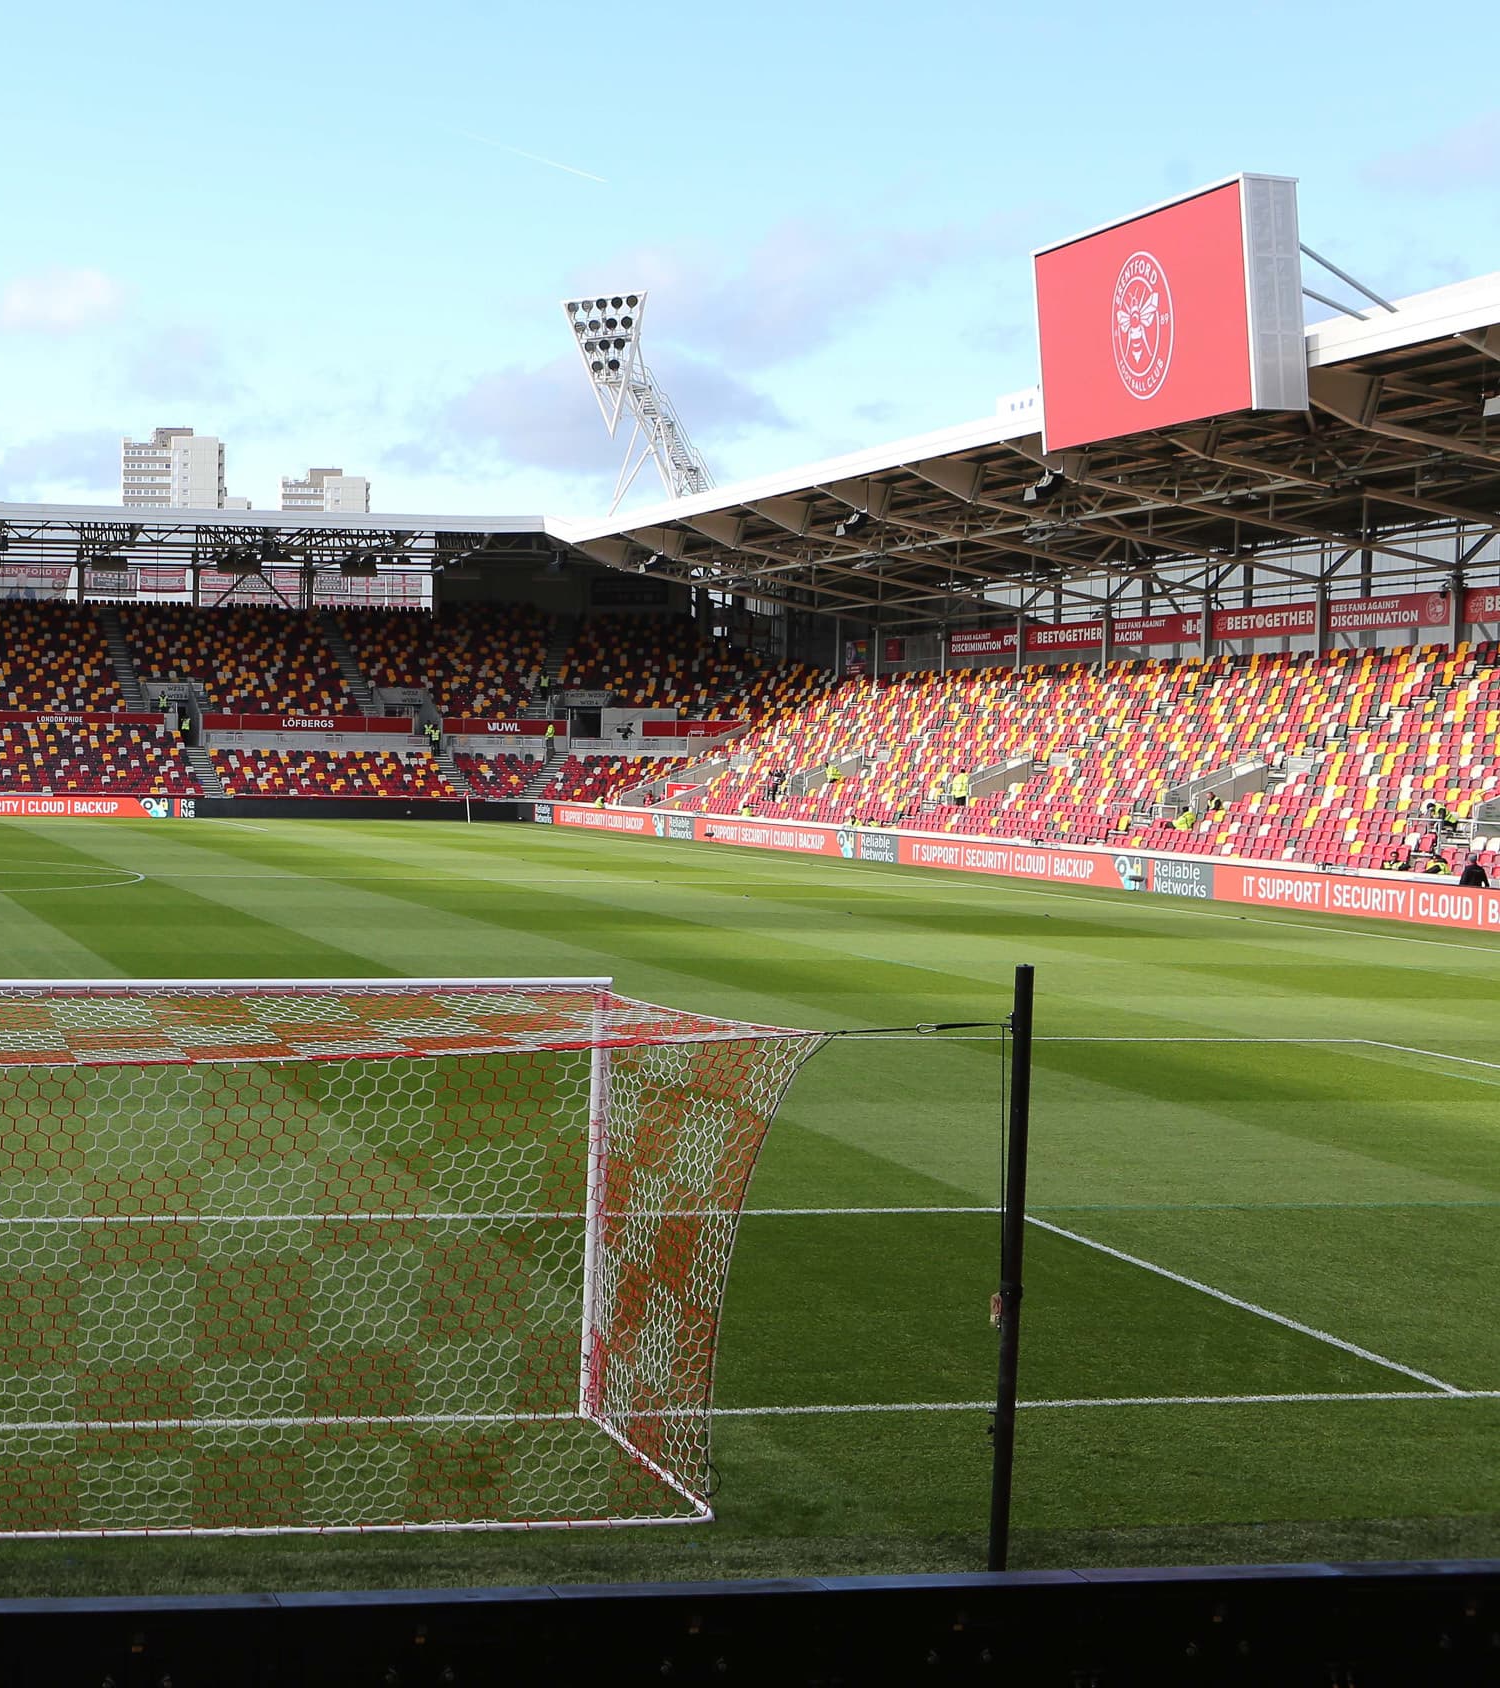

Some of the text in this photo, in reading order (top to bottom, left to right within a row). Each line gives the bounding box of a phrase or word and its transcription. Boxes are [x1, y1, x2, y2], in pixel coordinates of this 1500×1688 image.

[1115, 260, 1158, 305] BRENTFORD
[1148, 358, 1164, 388] CLUB
[1331, 600, 1400, 613] BEES FANS AGAINST
[1115, 619, 1166, 630] BEES FANS AGAINST
[1330, 610, 1419, 628] DISCRIMINATION
[1115, 631, 1143, 642] RACISM
[952, 641, 1001, 653] DISCRIMINATION
[37, 715, 63, 723] LONDON
[282, 717, 334, 728] LÖFBERGS
[28, 801, 64, 813] CLOUD
[74, 802, 118, 814] BACKUP
[668, 816, 690, 829] Reliable
[668, 826, 693, 840] Networks
[713, 825, 738, 843] SUPPORT
[742, 829, 770, 846] SECURITY
[773, 831, 794, 848] CLOUD
[799, 833, 825, 850] BACKUP
[861, 834, 890, 849] Reliable
[860, 847, 894, 862] Networks
[912, 844, 1094, 879] IT SUPPORT SECURITY CLOUD BACKUP
[1154, 861, 1200, 879] Reliable
[1154, 877, 1207, 898] Networks
[1243, 875, 1255, 897] IT
[1258, 877, 1322, 904] SUPPORT
[1333, 883, 1406, 914] SECURITY
[1419, 891, 1473, 921] CLOUD
